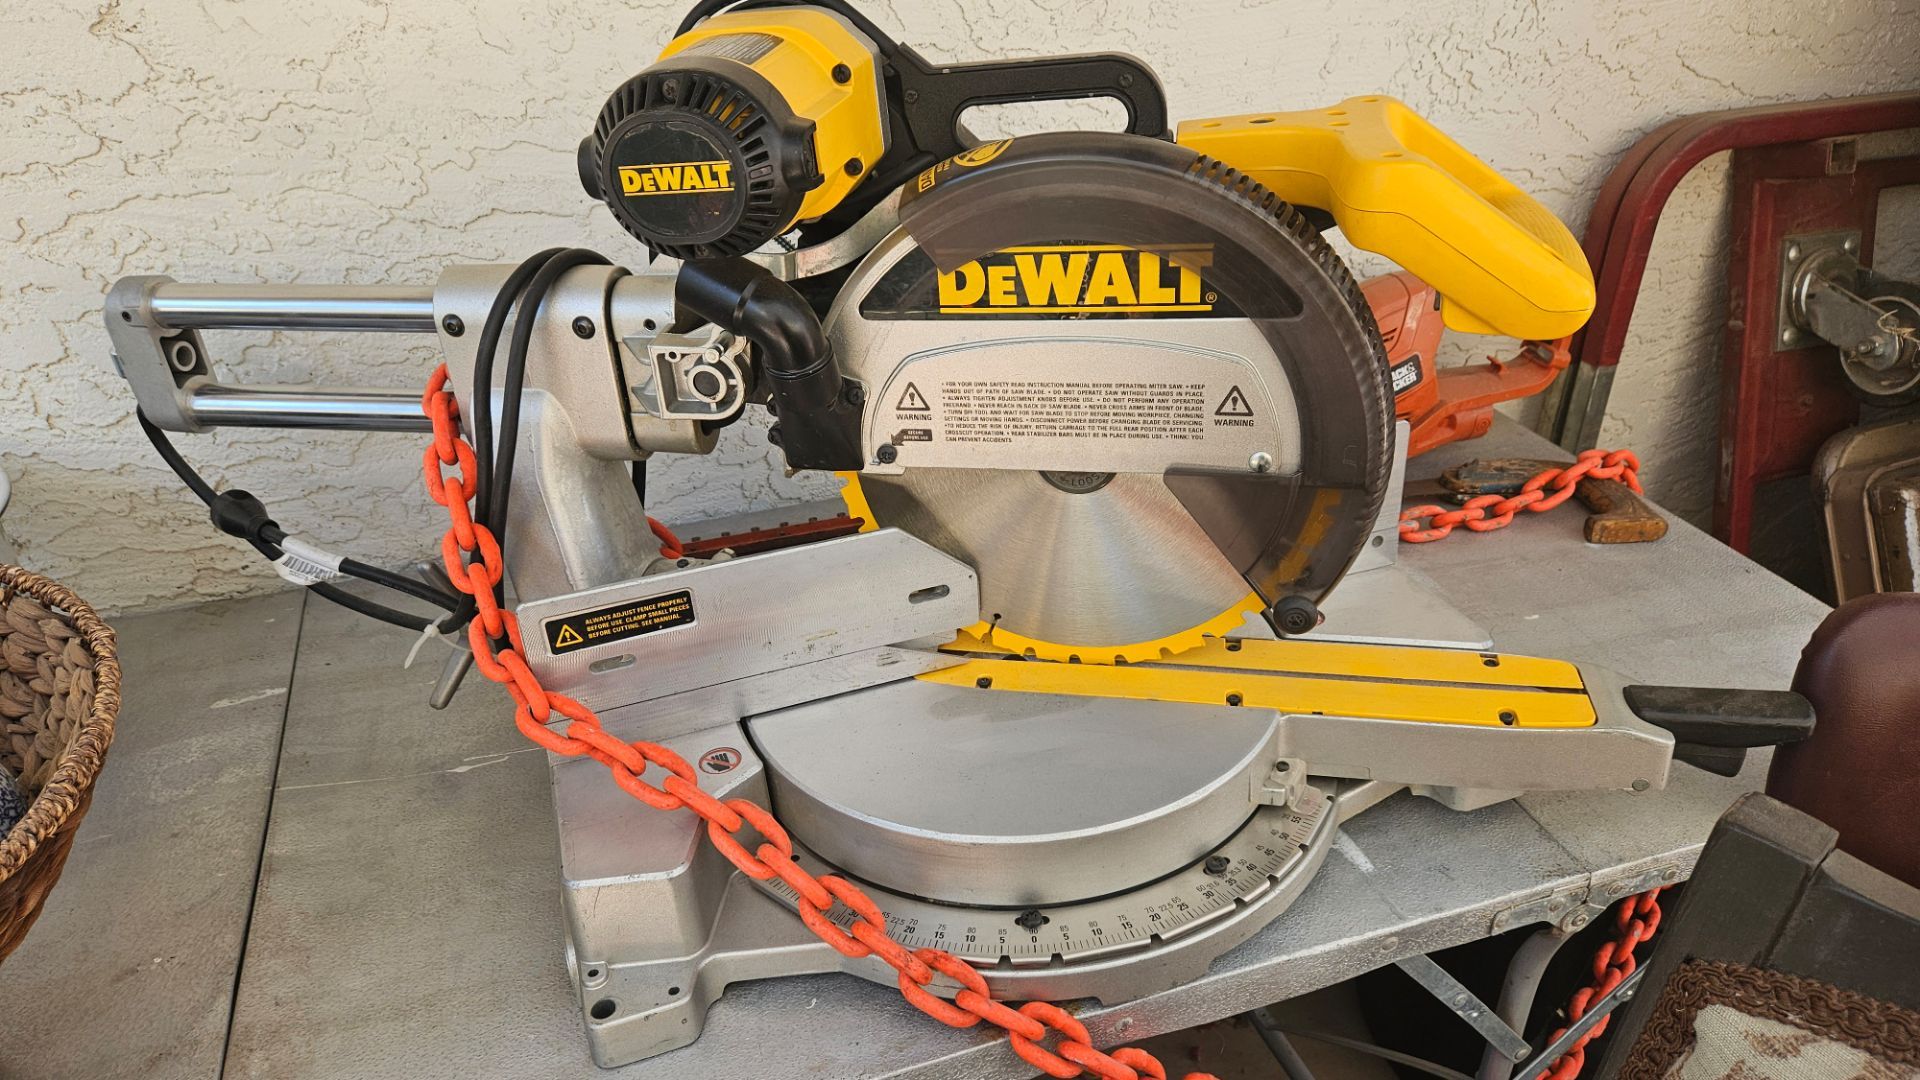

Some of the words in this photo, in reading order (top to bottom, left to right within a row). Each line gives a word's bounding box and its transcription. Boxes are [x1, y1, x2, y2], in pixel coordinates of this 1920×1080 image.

[619, 163, 731, 193] DEWALT
[937, 250, 1213, 305] DEWALT
[1214, 419, 1254, 427] WARNING
[586, 614, 612, 625] ALWAYS
[612, 608, 637, 619] ADJUST
[637, 604, 656, 614] FENCE
[657, 597, 688, 608] PROPERLY
[586, 622, 609, 632] BEFORE
[626, 612, 647, 623] CLAMP
[648, 608, 669, 619] SMALL
[669, 603, 690, 614] PIECES
[588, 628, 611, 639] BEFORE
[642, 619, 653, 627] SEE
[1290, 815, 1301, 824] 55
[1202, 890, 1214, 899] 30
[1176, 902, 1189, 911] 25
[1149, 912, 1161, 921] 20
[908, 918, 919, 926] 70
[1121, 921, 1133, 930] 15
[903, 926, 915, 934] 20
[1091, 928, 1103, 936] 10
[934, 931, 945, 939] 15
[965, 935, 976, 943] 10
[1063, 932, 1070, 941] 5
[1031, 936, 1038, 944] 0
